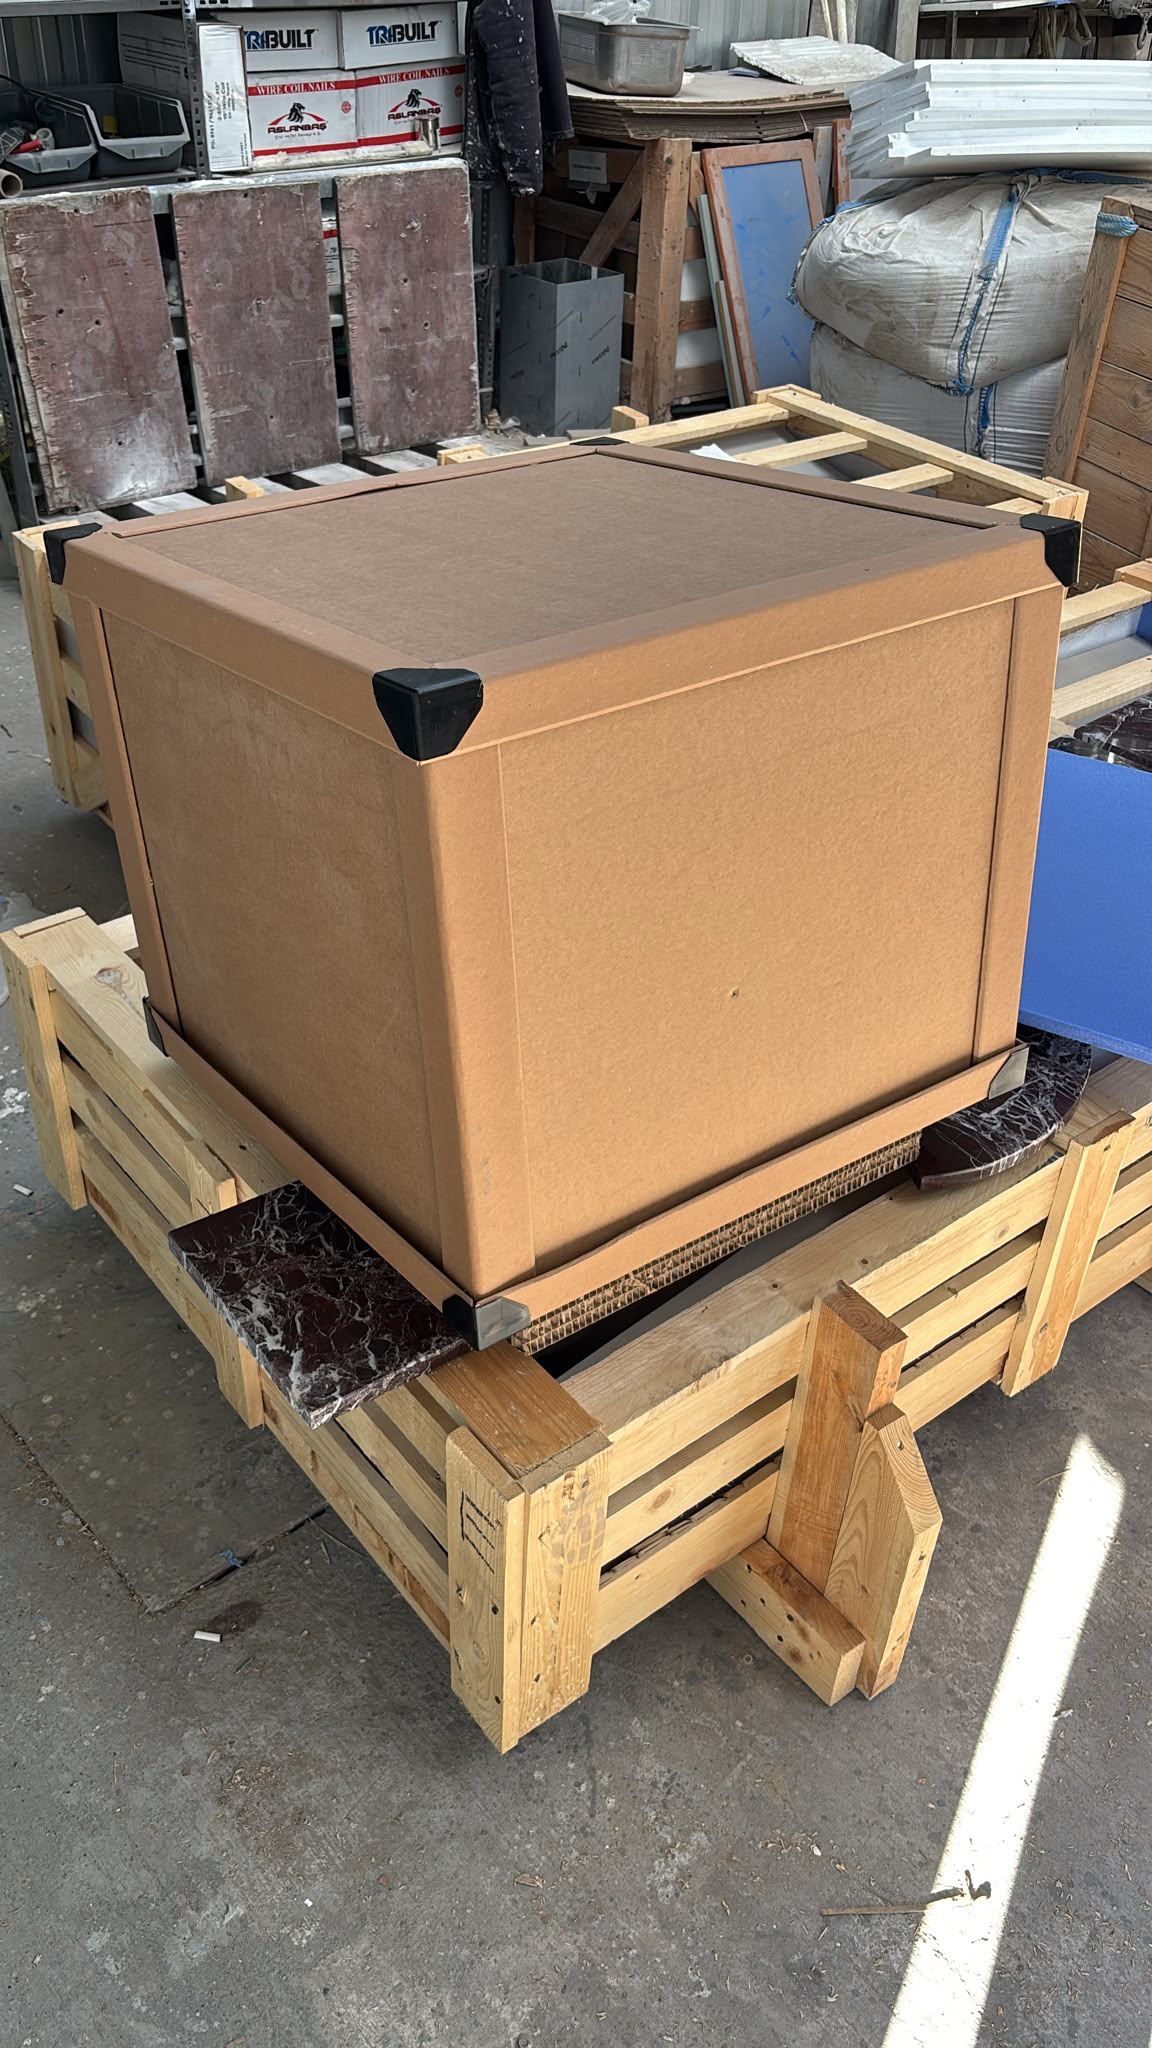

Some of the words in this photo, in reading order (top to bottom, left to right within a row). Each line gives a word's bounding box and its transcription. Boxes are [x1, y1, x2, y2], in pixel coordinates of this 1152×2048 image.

[379, 74, 401, 84] WIRE
[403, 71, 422, 81] COIL
[423, 67, 450, 78] NAILS
[257, 85, 283, 95] WIRE
[284, 83, 307, 93] COIL
[307, 82, 336, 92] NAILS
